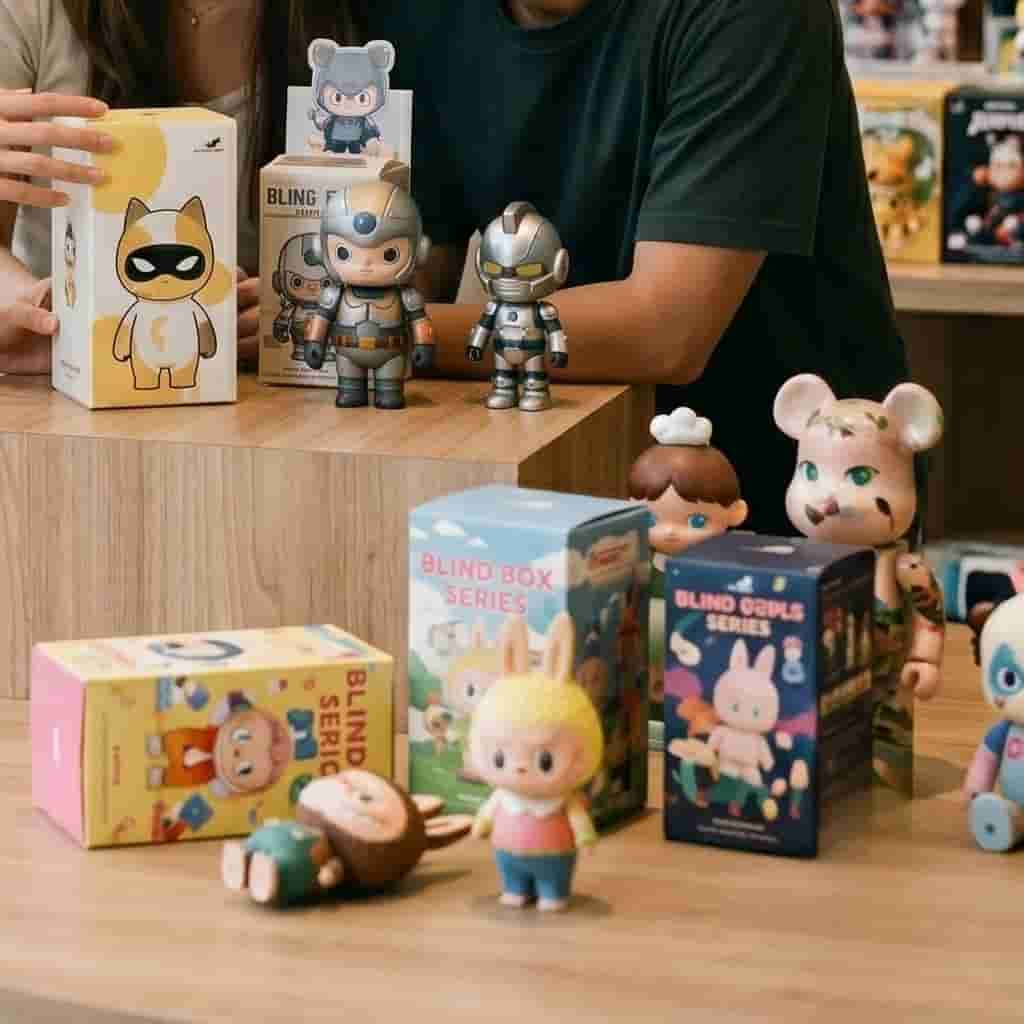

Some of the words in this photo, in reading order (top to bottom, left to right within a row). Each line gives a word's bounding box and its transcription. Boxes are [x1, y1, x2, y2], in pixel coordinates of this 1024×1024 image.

[267, 187, 317, 206] BLING
[421, 552, 493, 581] BLIND
[500, 564, 553, 592] BOX
[446, 584, 528, 614] SERIES
[674, 588, 736, 614] BLIND
[705, 612, 772, 638] SERIES
[346, 670, 367, 767] BLIND
